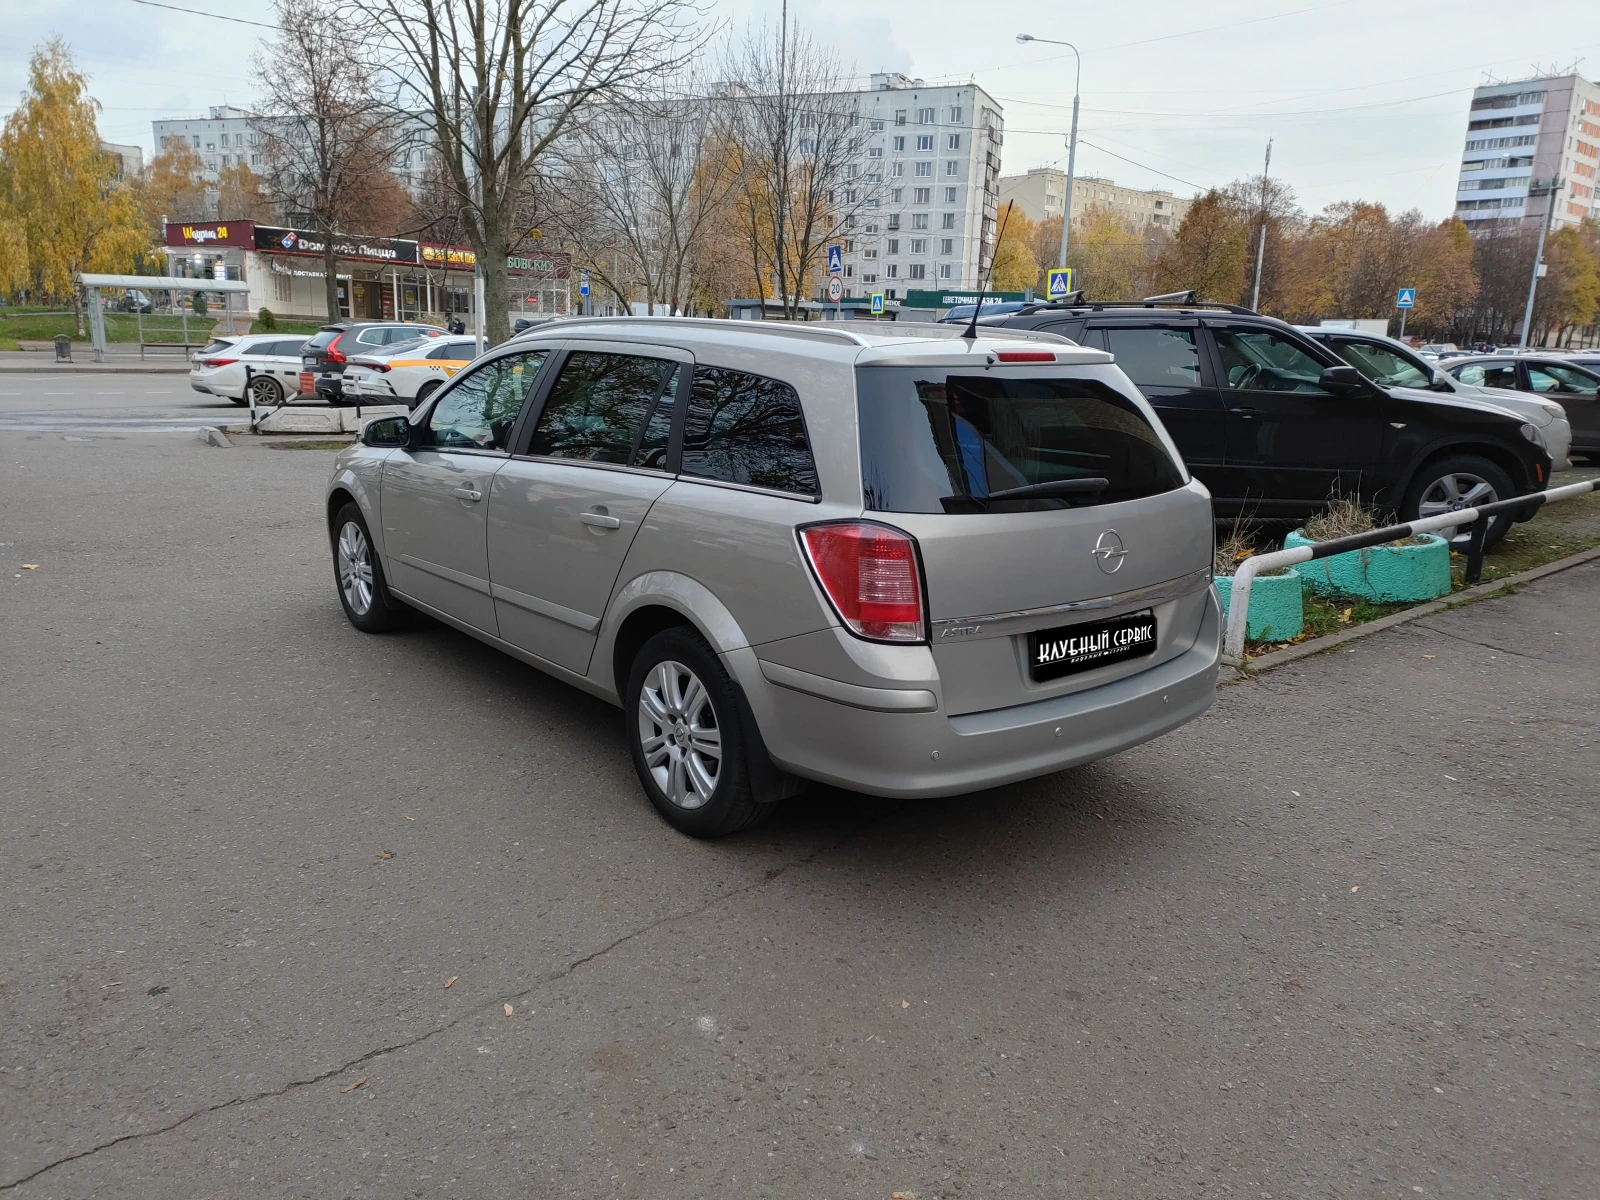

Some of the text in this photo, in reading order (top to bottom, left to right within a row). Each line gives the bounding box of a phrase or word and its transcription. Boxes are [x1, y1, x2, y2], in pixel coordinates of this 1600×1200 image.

[217, 226, 228, 239] 24
[358, 244, 397, 258] Пицца
[831, 283, 840, 295] 20
[942, 295, 977, 305] ЦВЕТОЧНАЯ
